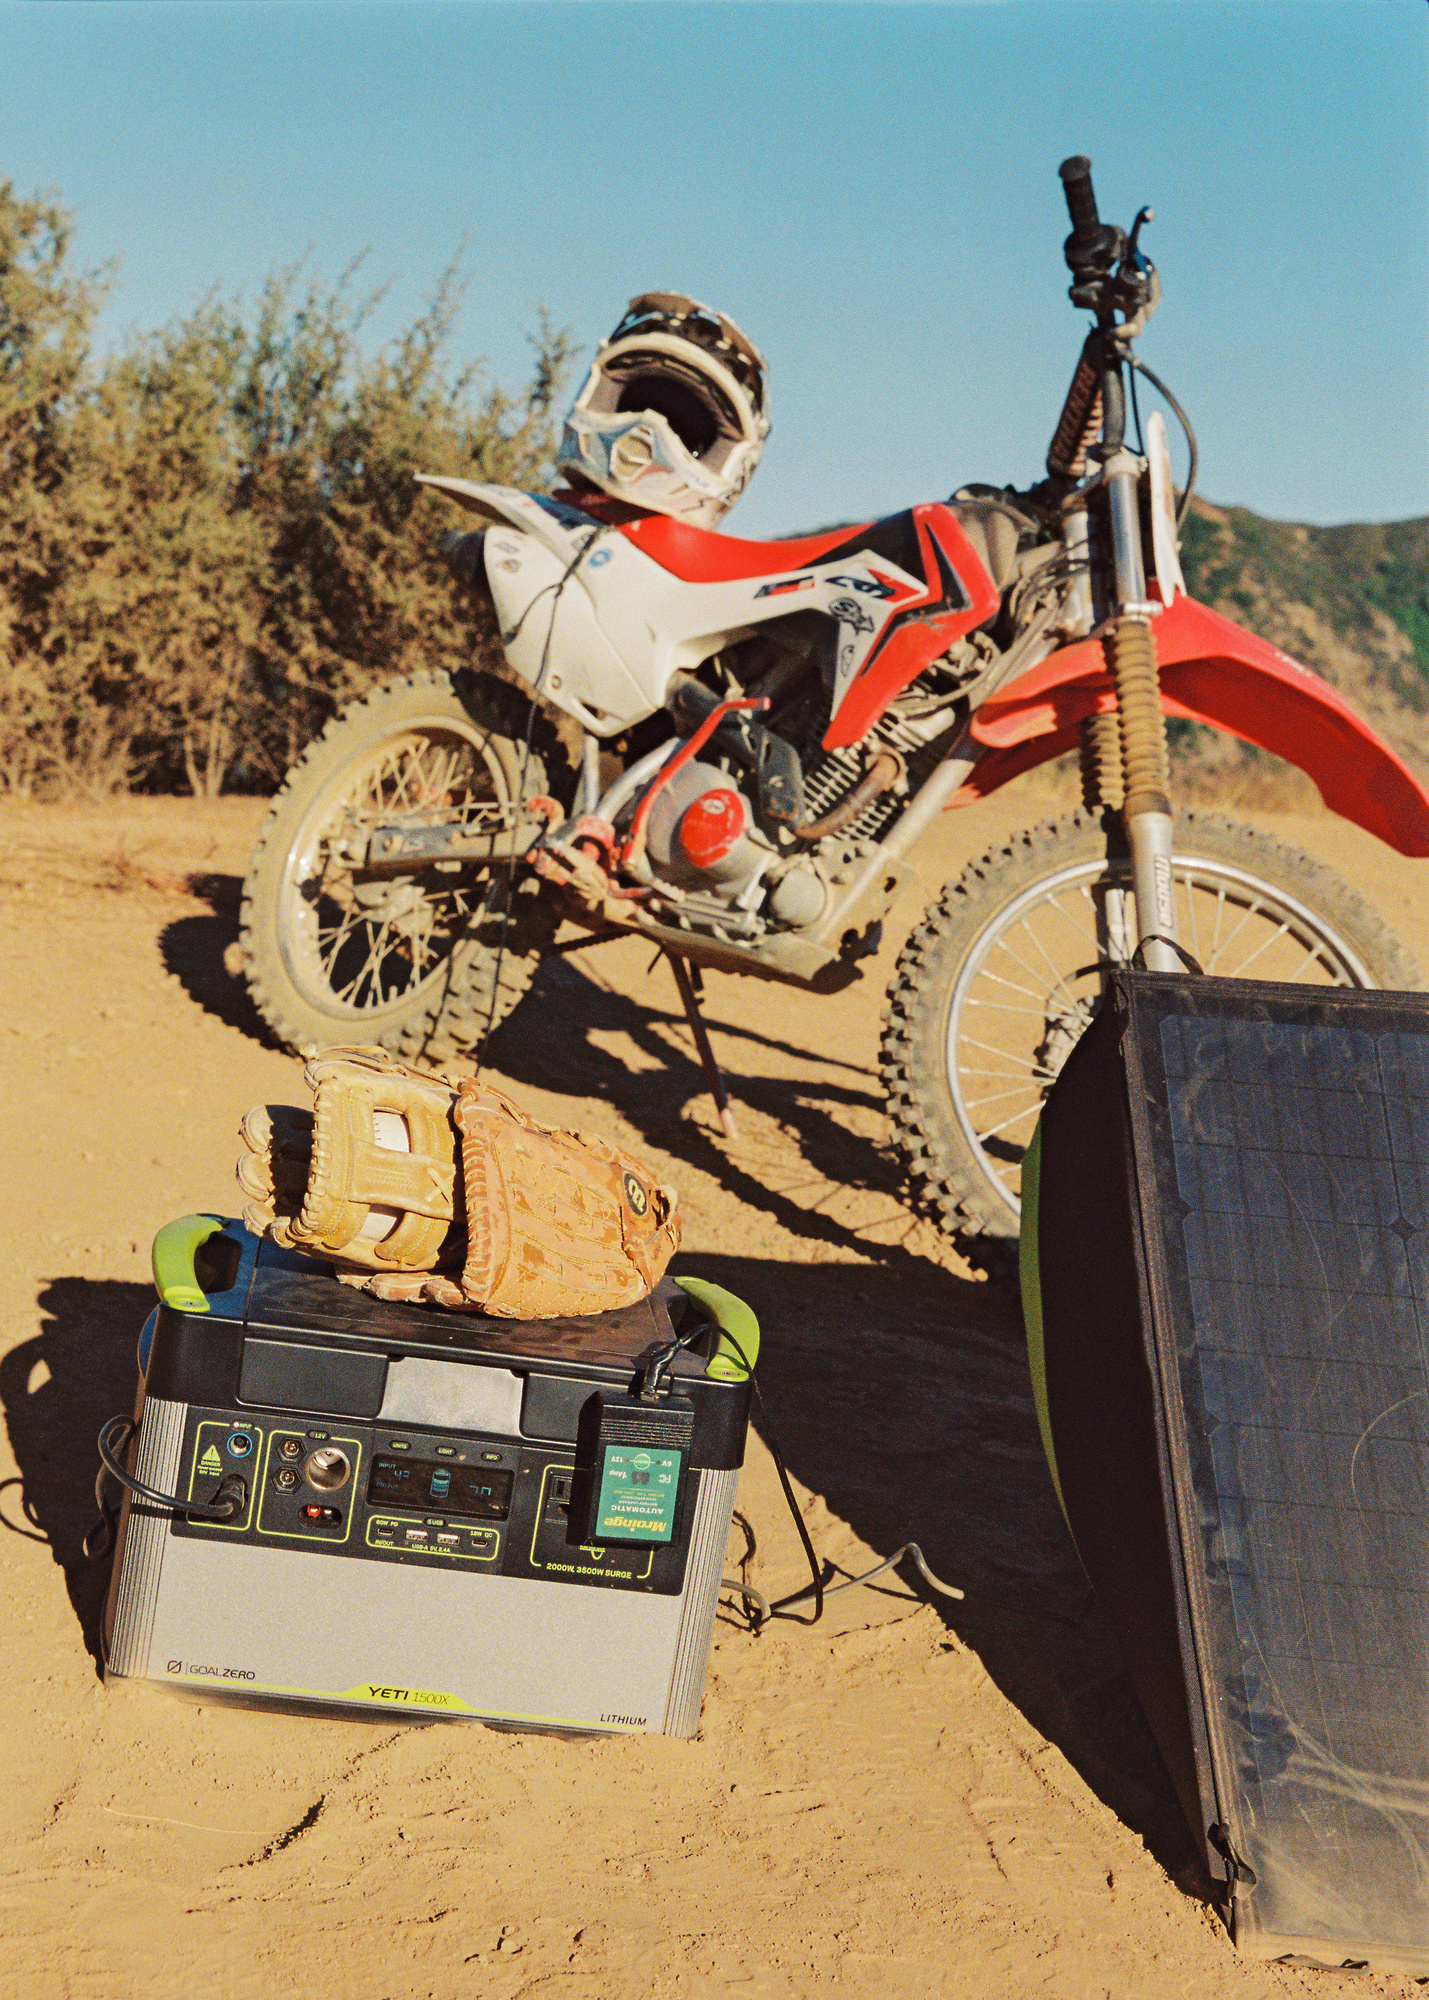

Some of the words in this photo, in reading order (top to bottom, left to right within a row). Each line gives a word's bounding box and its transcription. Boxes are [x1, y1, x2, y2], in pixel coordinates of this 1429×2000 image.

[611, 1504, 664, 1515] AUTOMATIC
[546, 1562, 575, 1573] 2000W,
[576, 1564, 604, 1576] 3500W
[605, 1569, 632, 1579] SURGE
[368, 1686, 409, 1701] YETI
[412, 1691, 450, 1705] 1500X
[600, 1713, 647, 1726] LITHIUM
